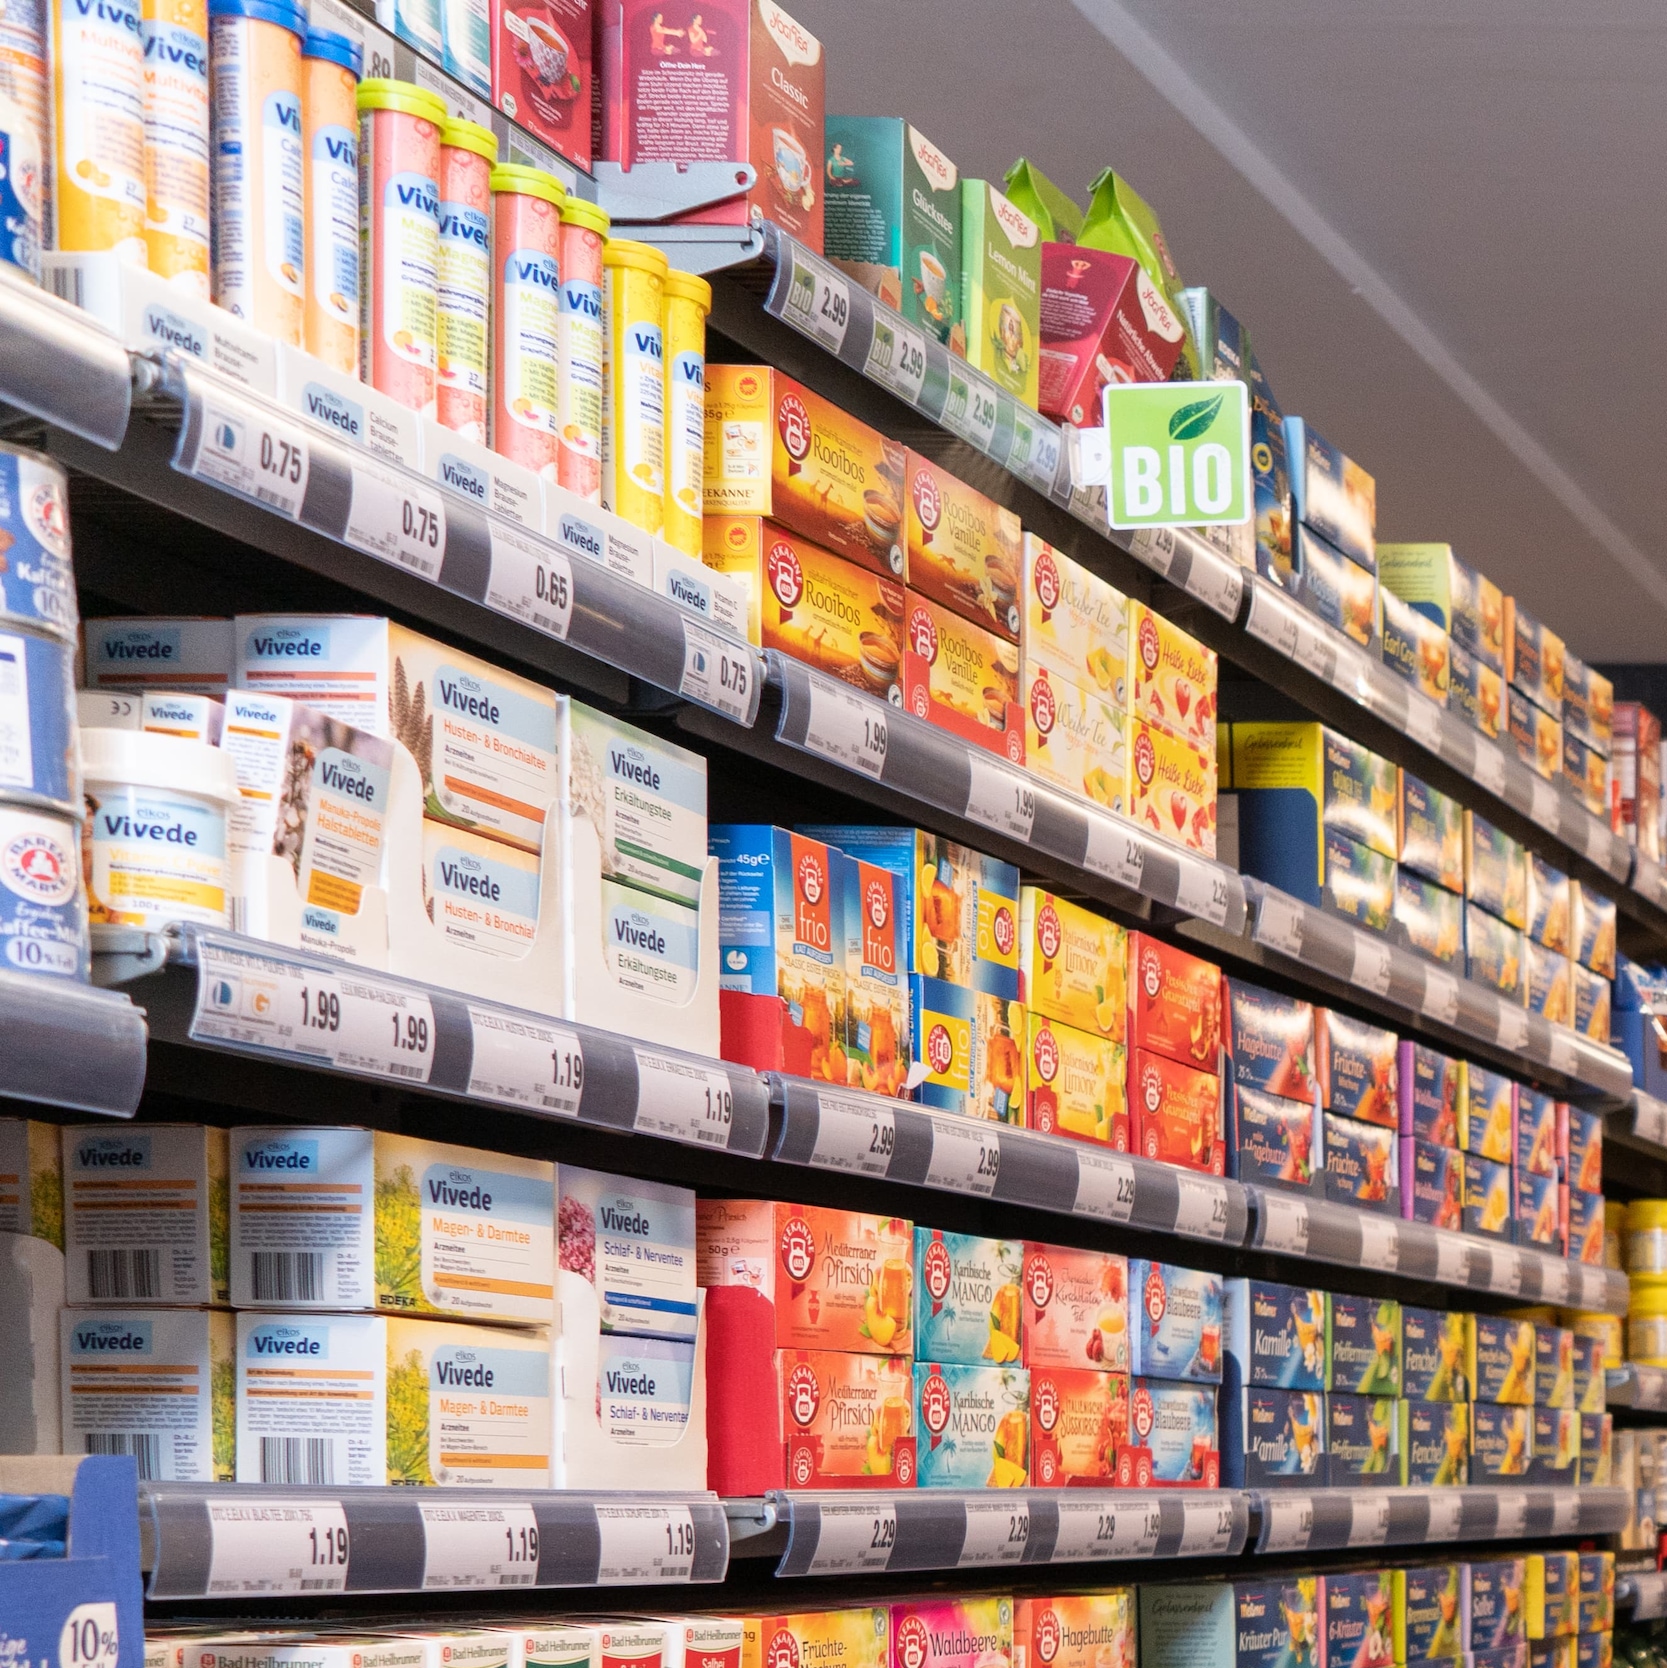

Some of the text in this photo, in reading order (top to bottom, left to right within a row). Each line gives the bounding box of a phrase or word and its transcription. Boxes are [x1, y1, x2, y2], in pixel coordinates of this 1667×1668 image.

[771, 66, 809, 109] Classic
[911, 188, 953, 234] Glückstee
[822, 284, 847, 327] 2.99
[261, 435, 301, 483] 0.75
[813, 441, 866, 484] Rooibos
[1124, 444, 1231, 517] BIO
[402, 500, 439, 547] 0.75
[536, 565, 568, 610] 0.65
[441, 679, 500, 726] Vivede
[444, 719, 480, 745] Husten-
[492, 734, 546, 771] Bronchialtee
[611, 749, 661, 791] Vivede
[615, 784, 672, 822] Erkältungstee
[104, 818, 198, 845] Vivede
[302, 985, 341, 1033] 1.99
[871, 1122, 894, 1157] 2.99
[429, 1180, 492, 1211] Vivede
[432, 1218, 474, 1238] Magen-
[488, 1227, 531, 1244] Darmtee
[601, 1206, 649, 1235] Vivede
[604, 1241, 632, 1261] Schlaf-
[644, 1249, 684, 1266] Nerventee
[823, 1254, 874, 1288] Pfirsich
[309, 1528, 348, 1566] 1.19
[873, 1519, 896, 1549] 2.29
[802, 1639, 848, 1661] Früchte-
[930, 1631, 998, 1656] Waldbeere
[1061, 1622, 1113, 1646] Hagebutte
